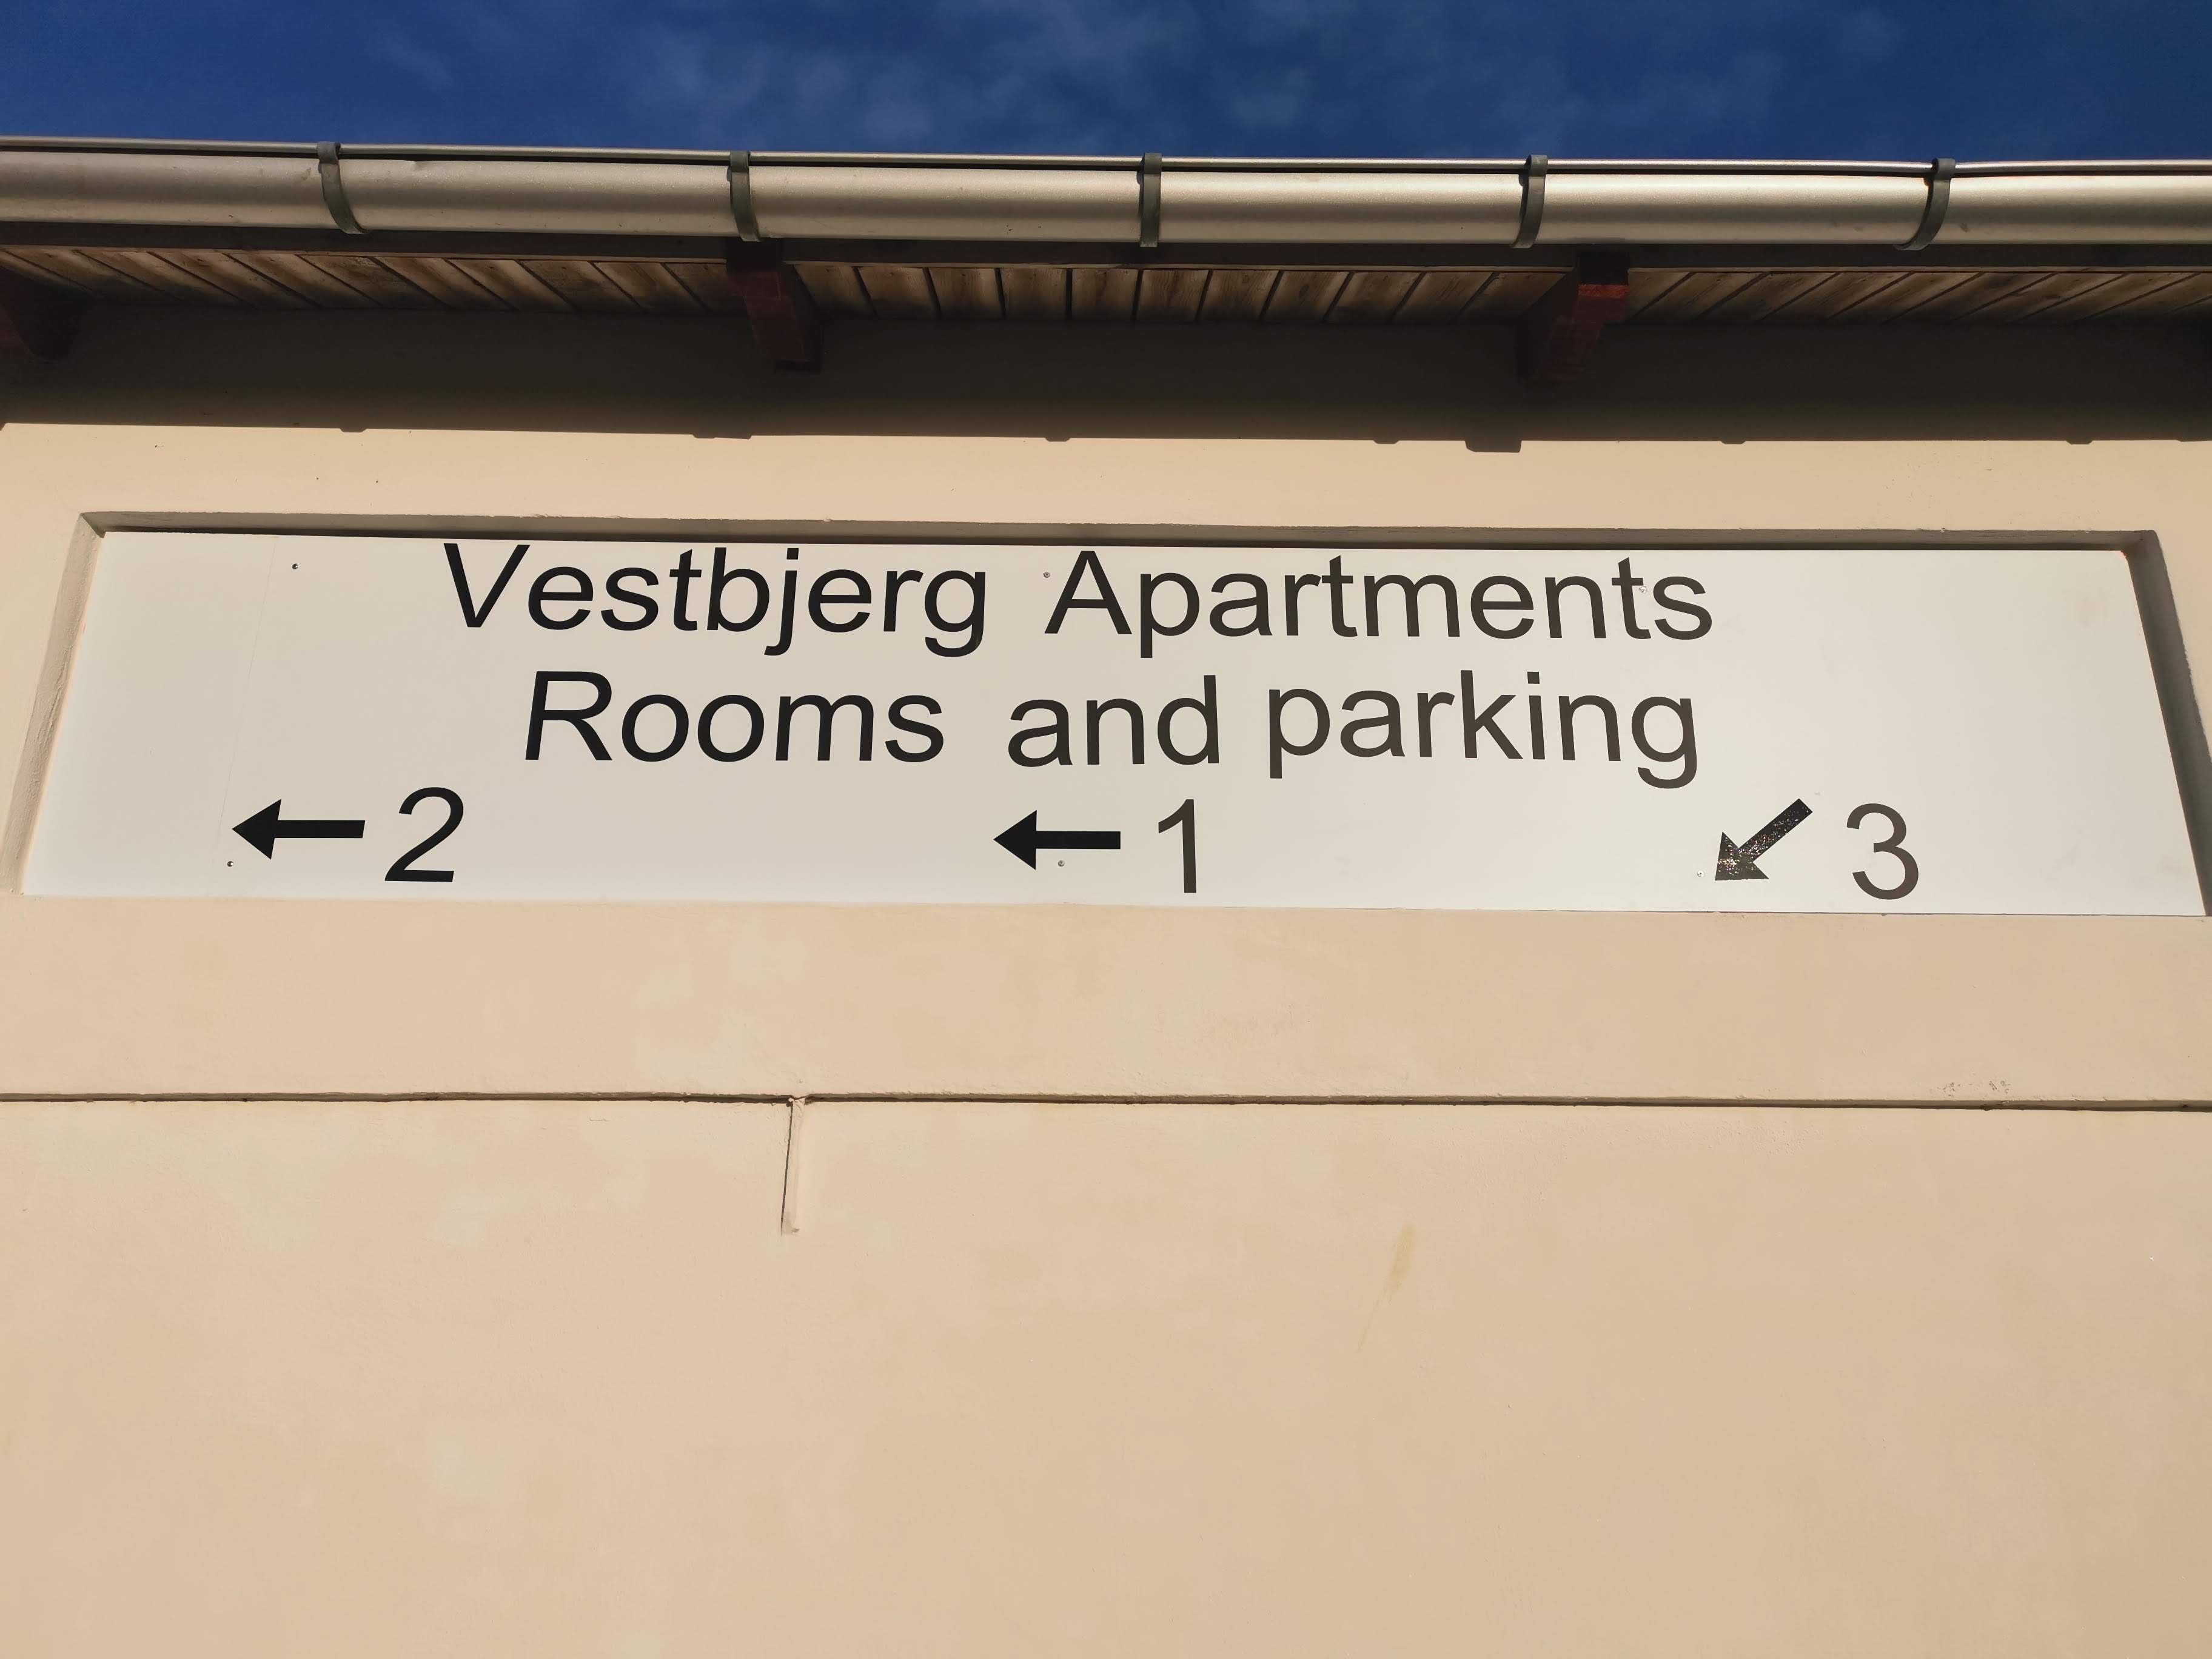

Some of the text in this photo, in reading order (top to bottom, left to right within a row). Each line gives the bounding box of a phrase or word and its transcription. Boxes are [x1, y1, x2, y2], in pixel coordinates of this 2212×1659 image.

[443, 543, 1712, 659] Vestbjerg Apartments
[525, 669, 1697, 789] Rooms and parking
[384, 786, 464, 883] 2
[1158, 799, 1197, 894] 1
[1846, 803, 1919, 900] 3
